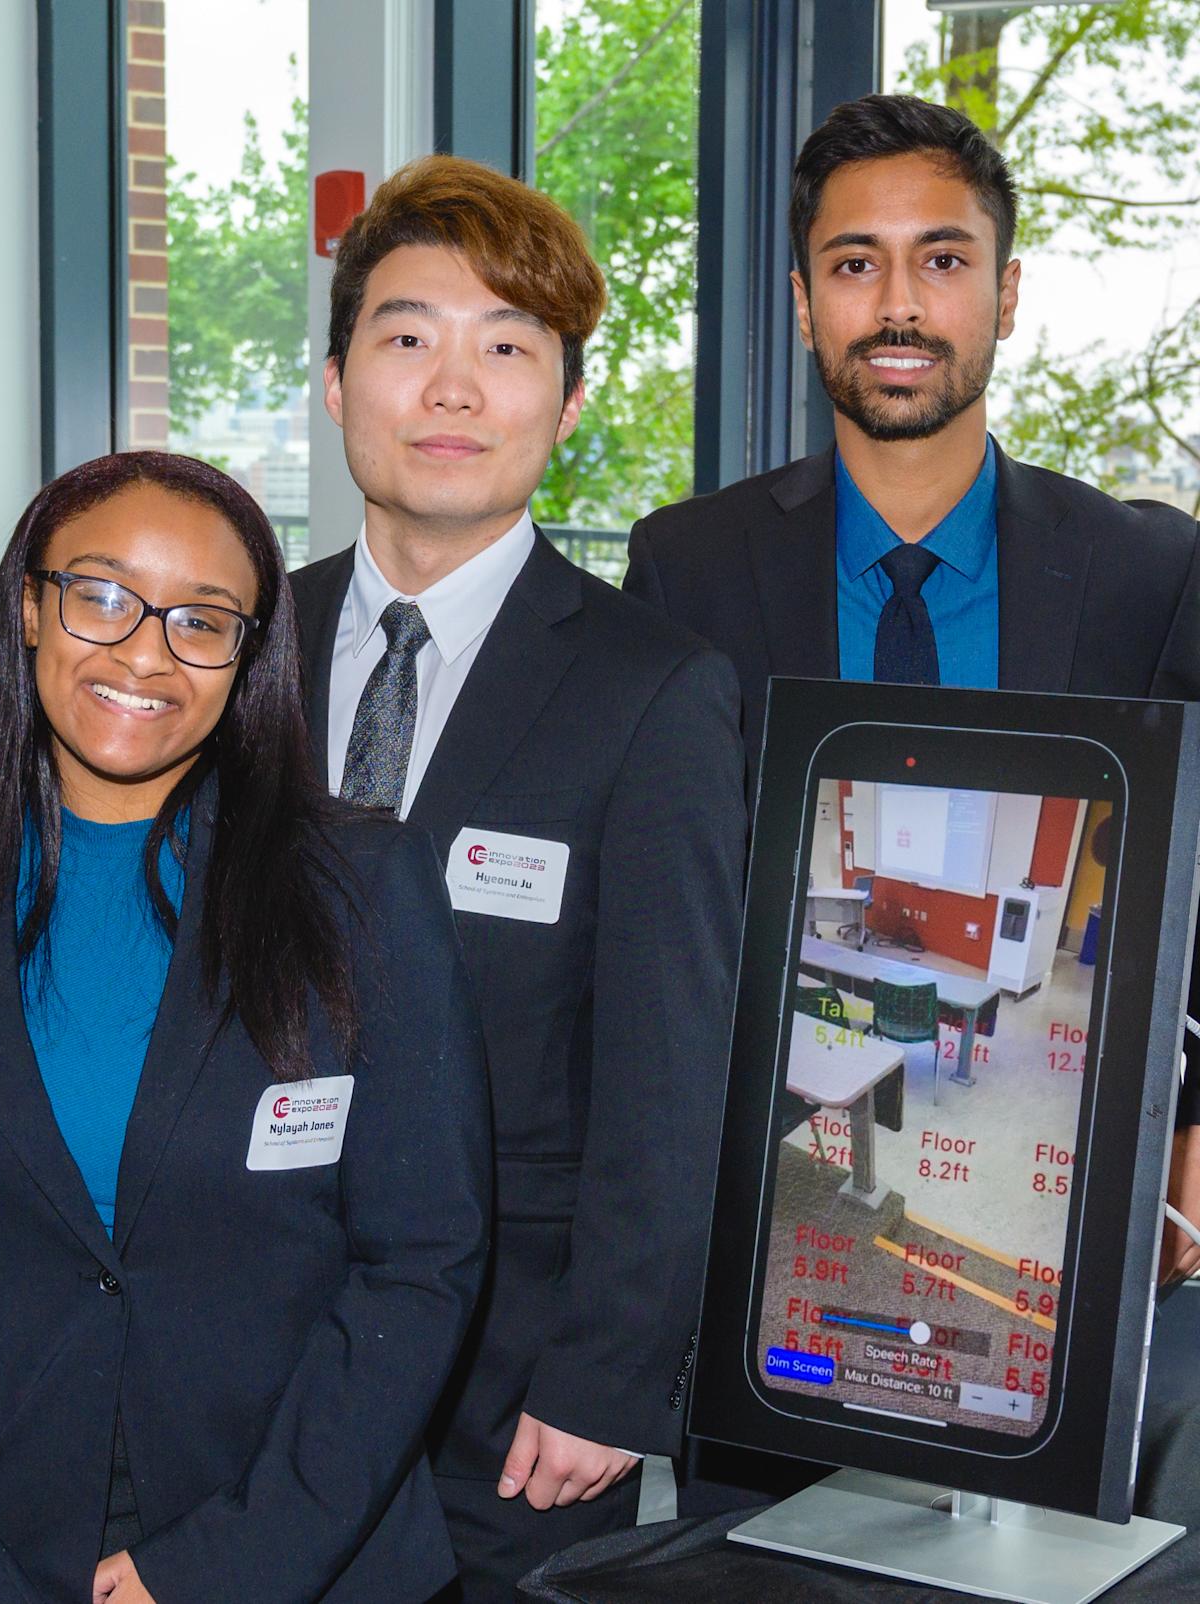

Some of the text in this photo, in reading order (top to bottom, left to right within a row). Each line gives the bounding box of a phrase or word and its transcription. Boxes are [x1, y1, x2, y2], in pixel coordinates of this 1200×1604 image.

[489, 851, 546, 865] innovation
[475, 872, 532, 889] Hyeonu Ju
[814, 1024, 865, 1048] 5.4ft
[1049, 1022, 1088, 1044] Flo
[934, 1040, 990, 1063] 12.ft
[291, 1103, 338, 1114] expo2023
[292, 1097, 339, 1106] innovation
[269, 1121, 334, 1136] Nylayah Jones
[921, 1131, 977, 1155] Floor
[918, 1159, 970, 1183] 8.2ft
[1032, 1173, 1068, 1195] 8.5
[794, 1223, 856, 1254] Floor
[904, 1242, 966, 1271] Floor
[792, 1255, 849, 1285] 5.9ft
[902, 1271, 957, 1300] 5.7ft
[865, 1345, 938, 1369] Speech Rate
[1008, 1333, 1054, 1361] Flo
[767, 1355, 833, 1377] Dim Screen
[844, 1369, 953, 1400] Max Distance: 10 ft
[1005, 1367, 1046, 1396] 5.5
